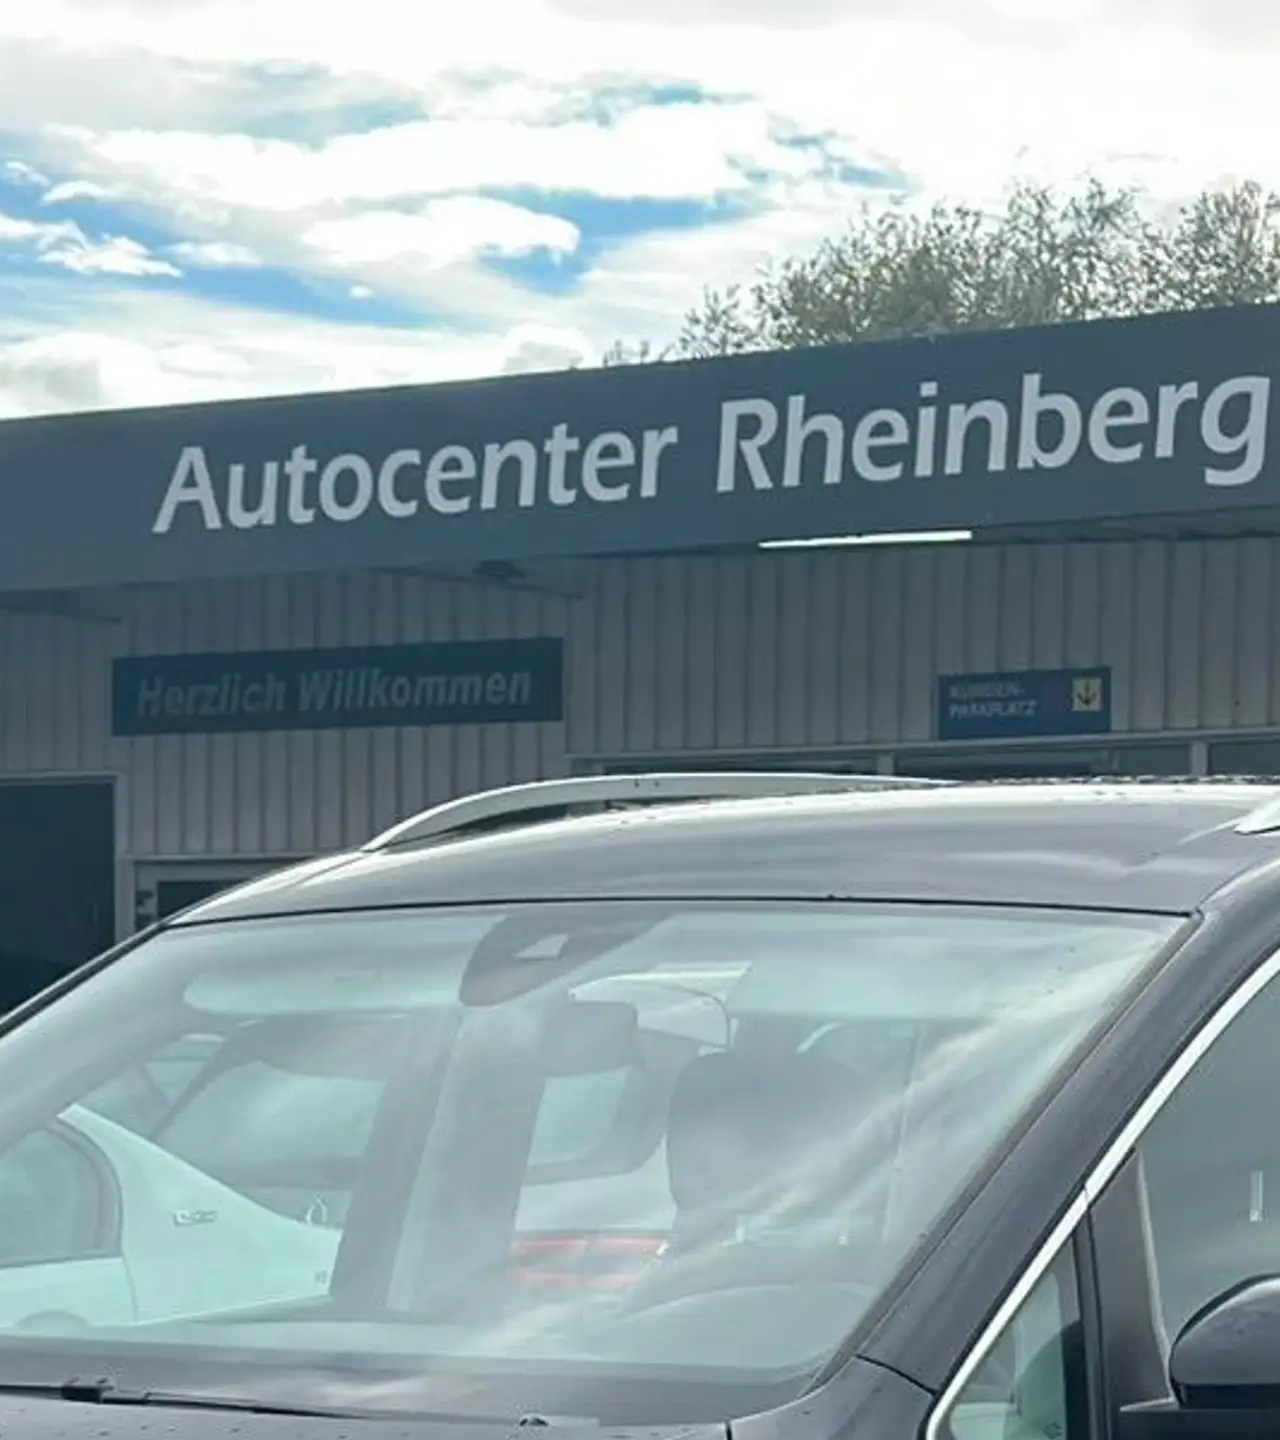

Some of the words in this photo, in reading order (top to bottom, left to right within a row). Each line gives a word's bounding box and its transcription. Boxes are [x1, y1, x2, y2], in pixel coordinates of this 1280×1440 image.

[153, 421, 679, 536] Autocenter
[716, 372, 1272, 489] Rheinberg
[136, 671, 286, 718] Herzlich
[298, 666, 533, 713] Willkommen
